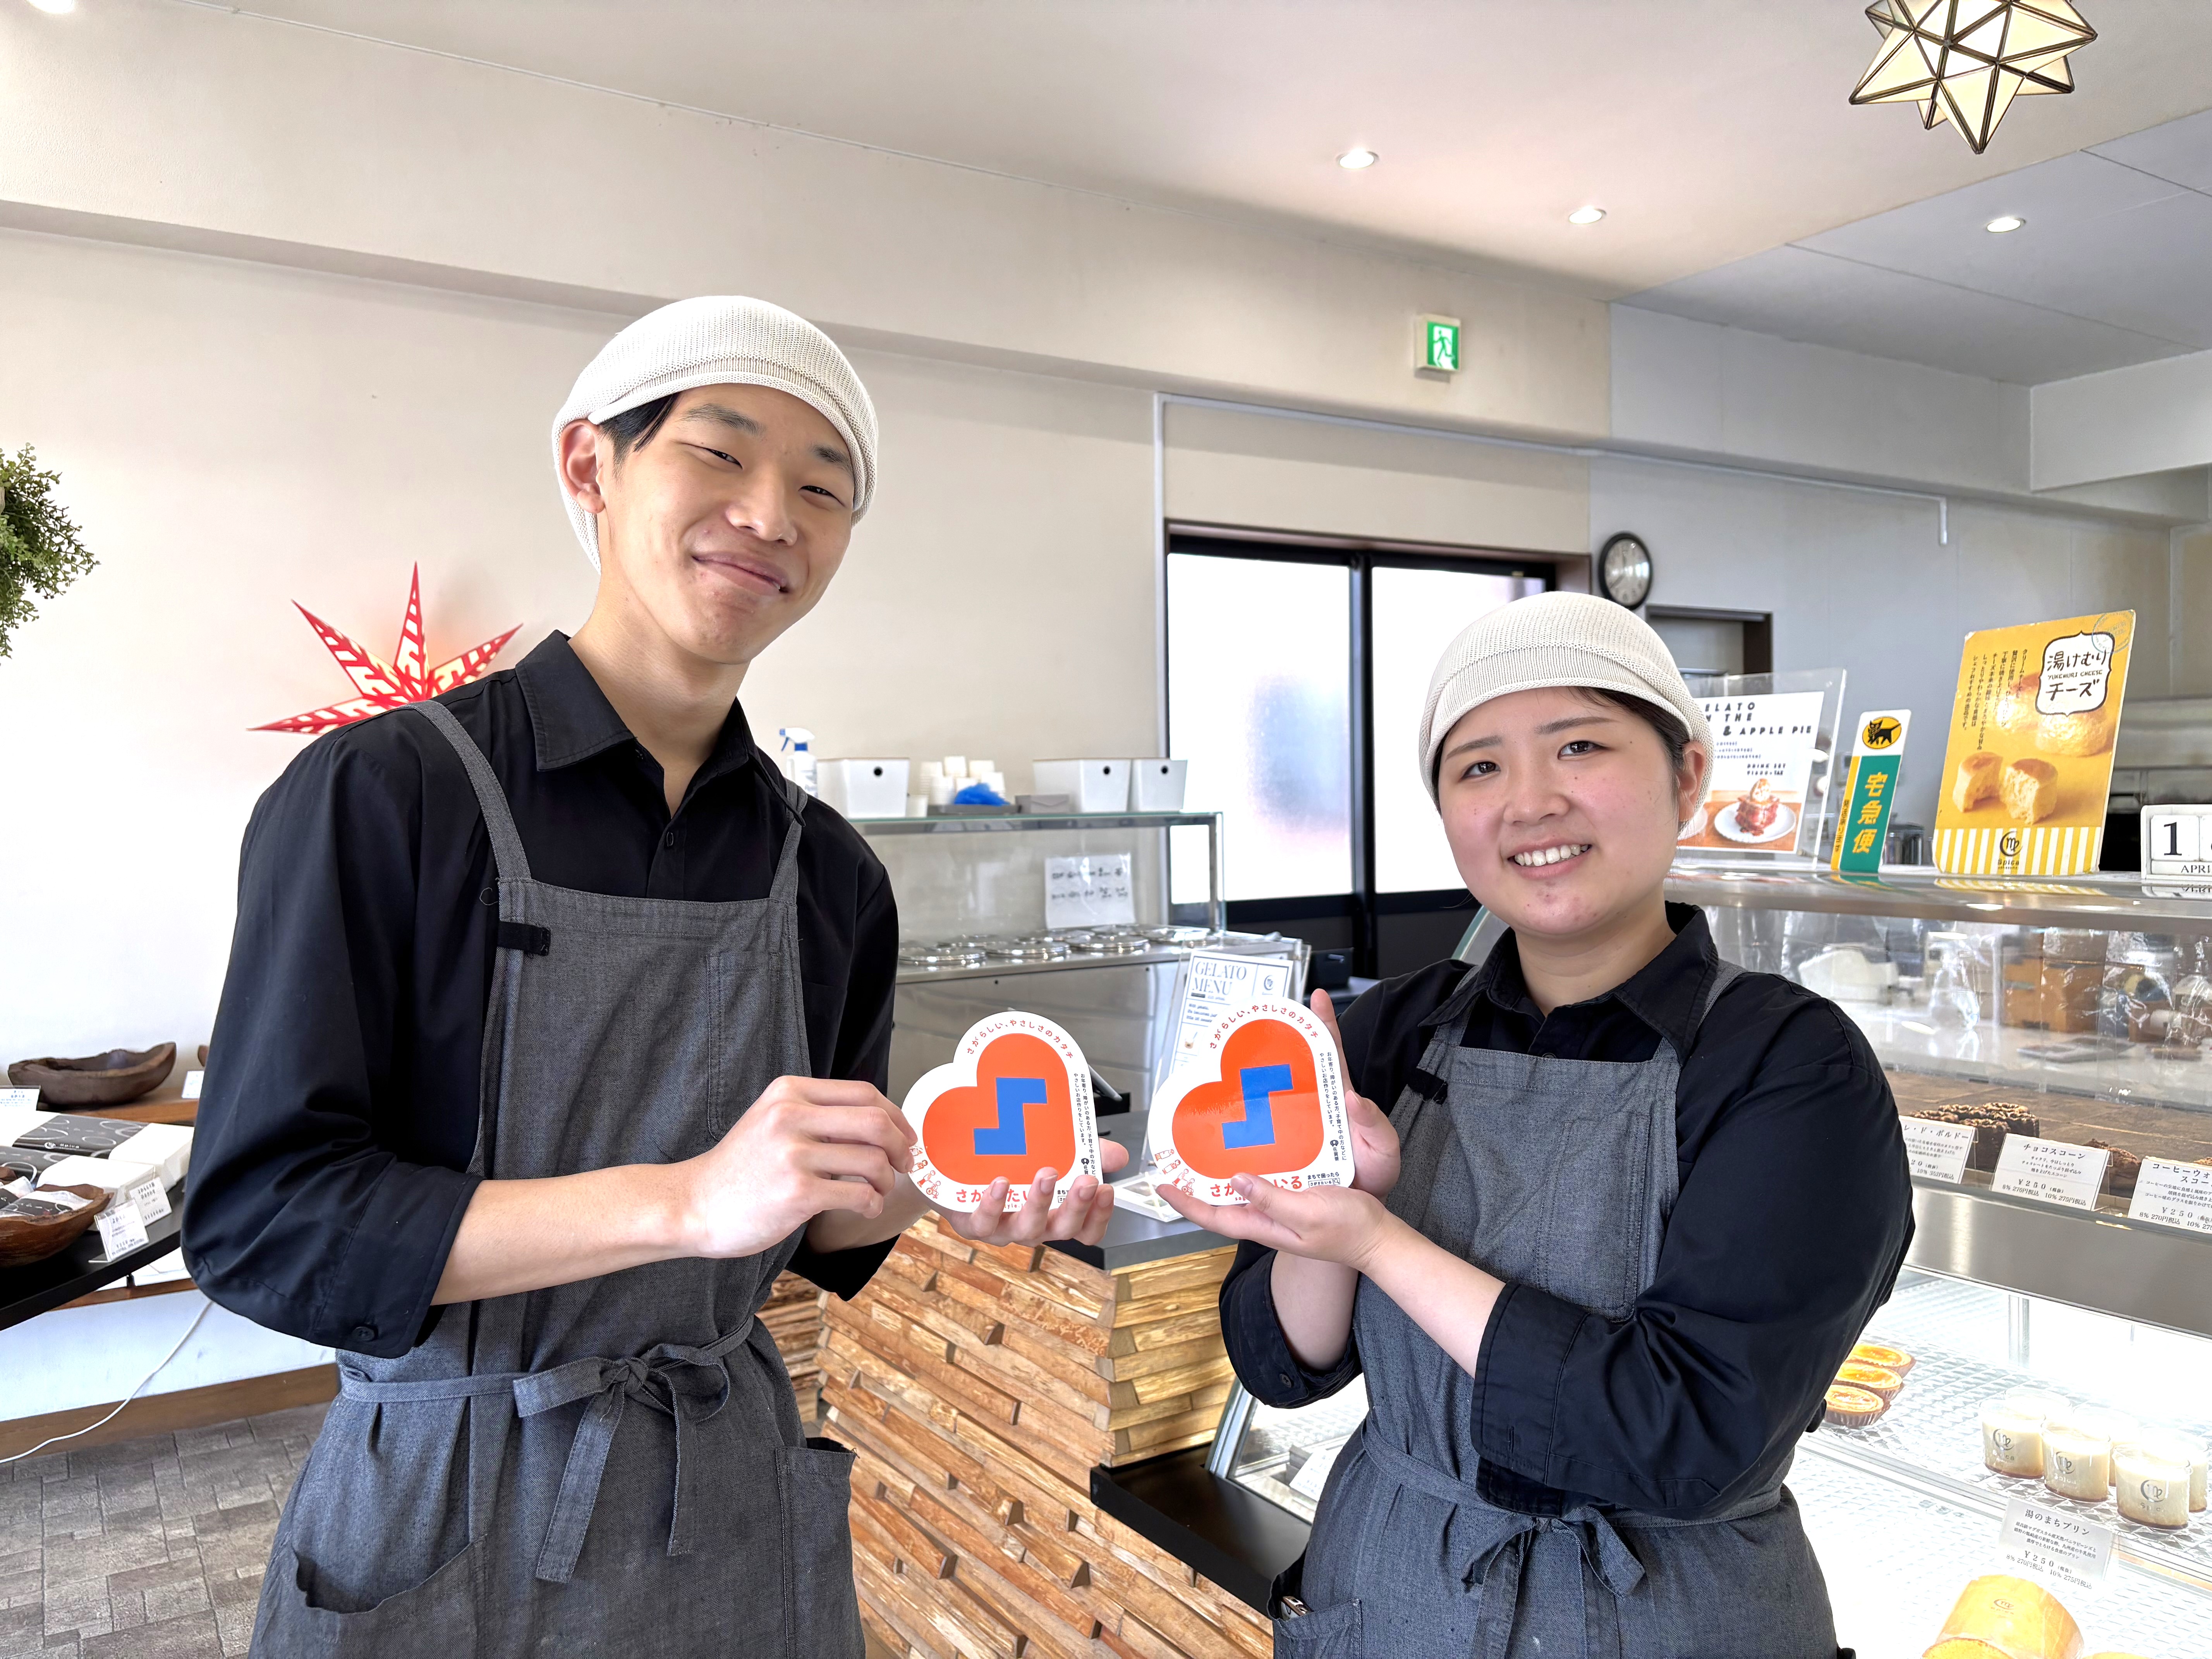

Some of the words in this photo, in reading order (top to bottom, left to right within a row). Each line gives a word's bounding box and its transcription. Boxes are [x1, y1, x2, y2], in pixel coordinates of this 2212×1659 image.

[2047, 649, 2106, 672] 湯けむり
[2047, 672, 2078, 680] YUKEMURI
[2045, 678, 2100, 701] チーズ
[1705, 701, 1755, 712] ELATO
[1724, 713, 1753, 722] THE
[1723, 725, 1732, 736] &
[1739, 726, 1784, 735] APPLE
[1791, 725, 1812, 734] PIE
[1852, 772, 1888, 854] 宅急便
[2181, 865, 2210, 874] APRI
[1195, 961, 1247, 980] GELATO
[1192, 977, 1232, 996] MENU
[1210, 1004, 1318, 1049] さがらしい、やさしさのカタチ
[967, 1019, 1073, 1058] さがらしい、やさしさのカタチ
[1319, 1053, 1334, 1127] やさしいお店作りをしています。
[2023, 1144, 2086, 1159] チョコスコーン
[1307, 1172, 1340, 1180] まちで困ったら
[2152, 1163, 2210, 1179] コーヒーウォ
[2180, 1176, 2212, 1187] スコー
[2151, 1214, 2180, 1224] 270円税込
[2025, 1508, 2090, 1535] 湯のまちプリン
[2017, 1558, 2044, 1572] 270円税込
[2050, 1569, 2062, 1578] 10%
[2063, 1574, 2092, 1589] 275円税込
